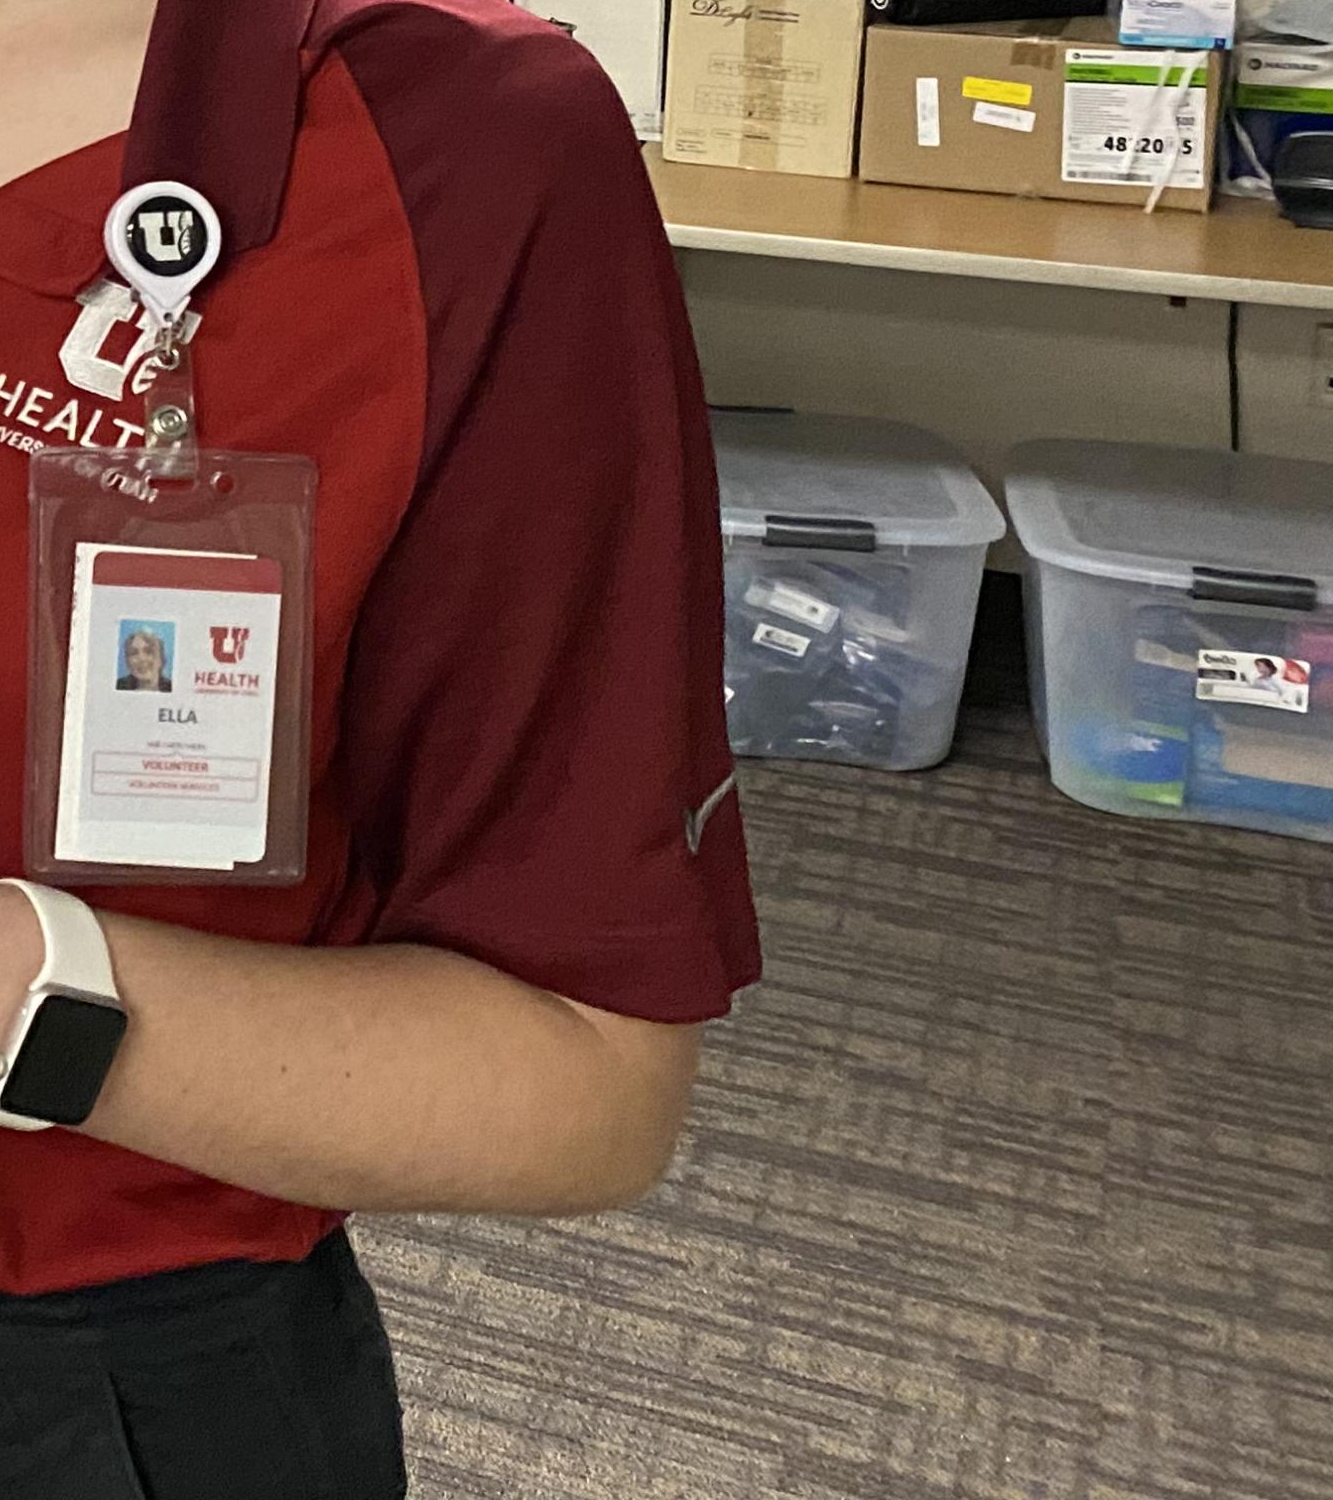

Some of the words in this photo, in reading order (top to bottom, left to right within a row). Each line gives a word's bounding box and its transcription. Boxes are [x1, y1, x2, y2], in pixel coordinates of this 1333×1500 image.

[195, 670, 260, 689] HEALTH
[157, 707, 198, 725] ELLA
[142, 758, 209, 774] VOLUNTEER
